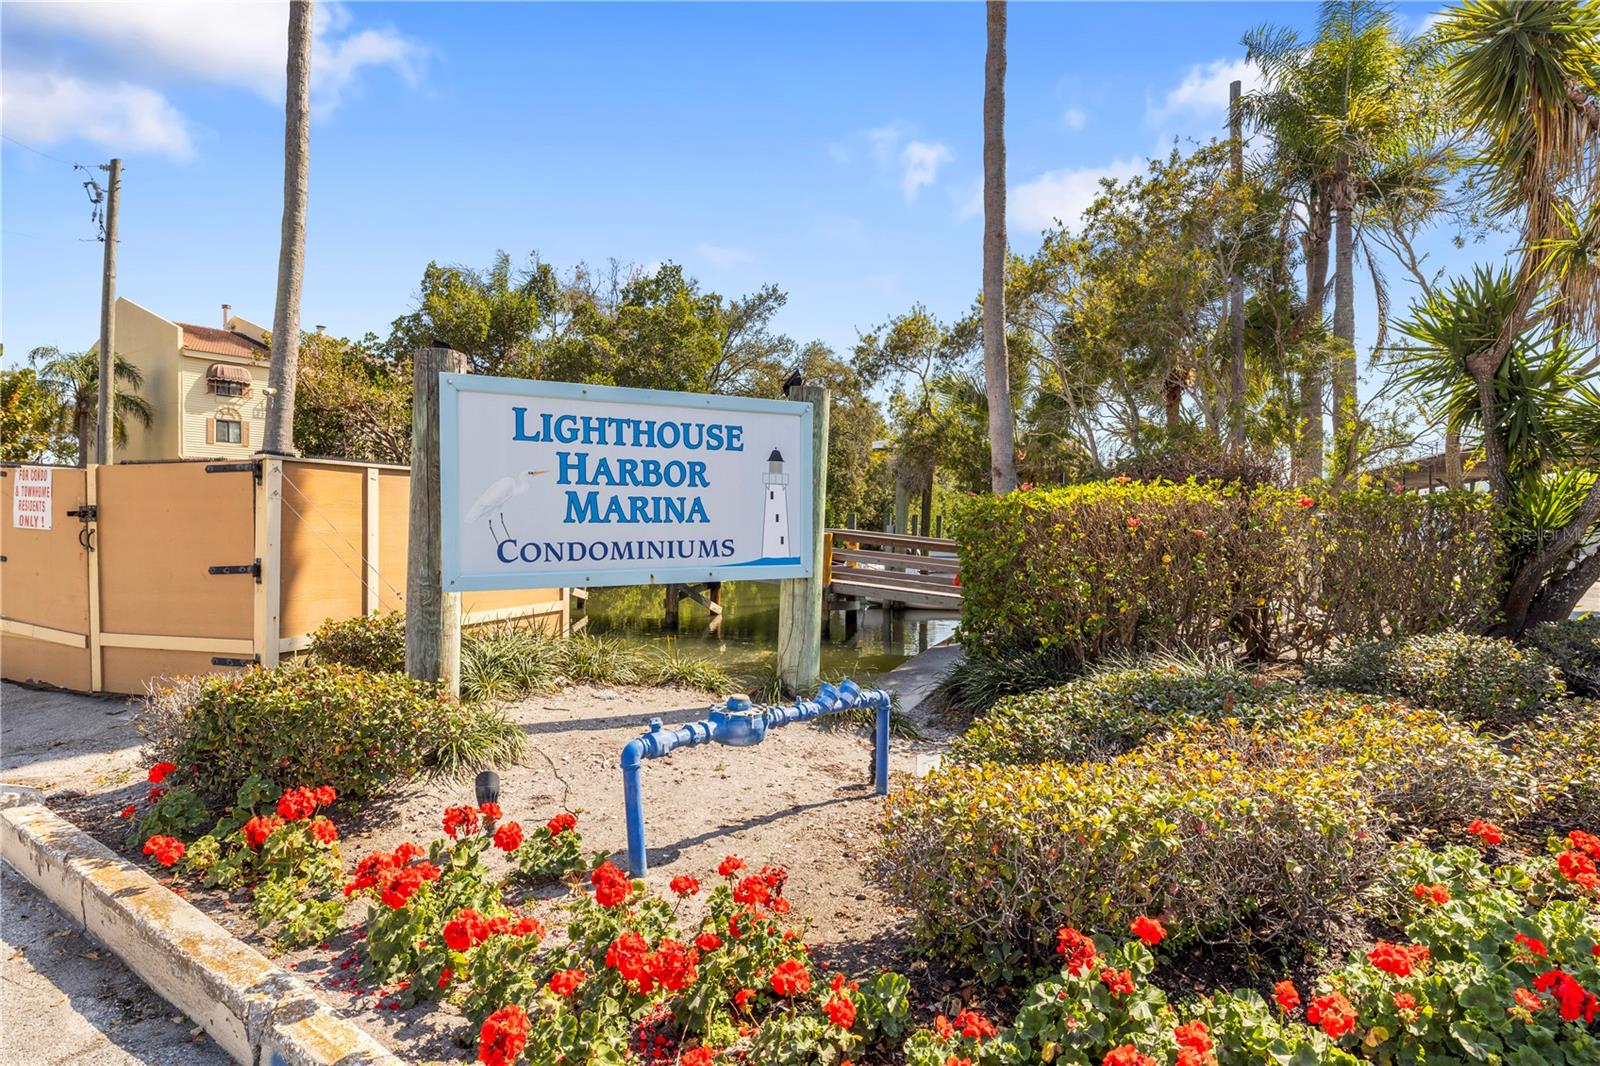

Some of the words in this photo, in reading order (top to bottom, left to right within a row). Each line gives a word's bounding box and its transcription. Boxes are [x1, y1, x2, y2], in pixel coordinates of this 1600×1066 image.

[512, 407, 744, 451] LIGHTHOUSE
[19, 469, 29, 480] FOR
[31, 469, 48, 481] CONDO
[556, 452, 710, 487] HARBOR
[21, 486, 50, 497] TOWNHOME
[18, 500, 46, 512] RESIDENTS
[563, 491, 711, 524] MARINA
[19, 515, 39, 528] ONLY
[496, 539, 735, 563] CONDOMINIUMS
